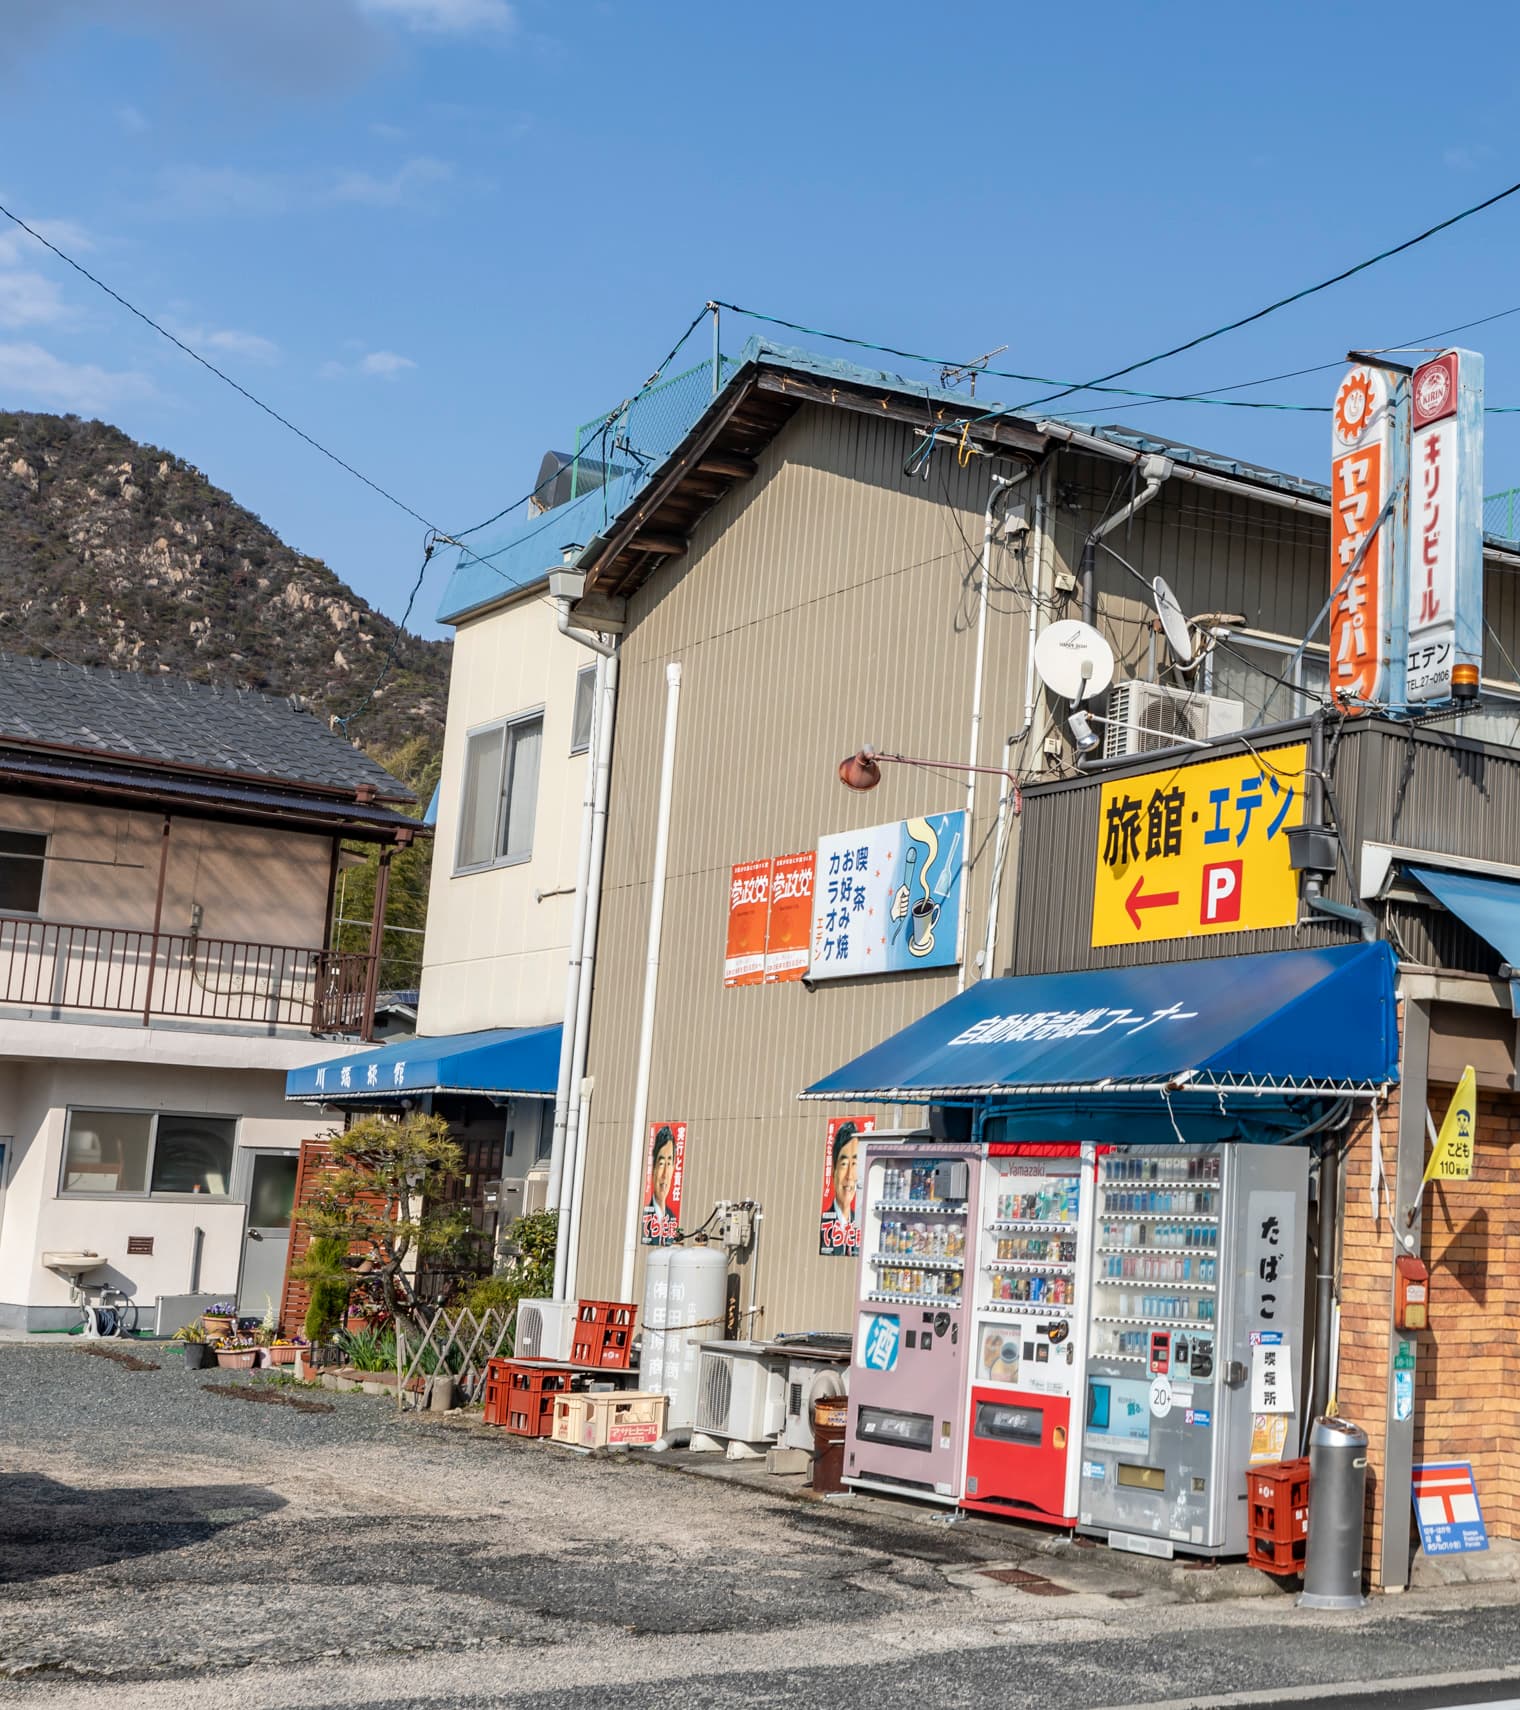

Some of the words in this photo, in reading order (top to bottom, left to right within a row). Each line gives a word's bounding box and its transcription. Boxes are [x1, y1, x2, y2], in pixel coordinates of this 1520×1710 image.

[1423, 388, 1444, 404] KIRIN
[1419, 432, 1442, 624] キリンビール
[1407, 643, 1450, 672] エデン
[731, 874, 768, 911] 参政党
[773, 867, 812, 905] 参政党
[852, 846, 869, 912] 喫茶
[1206, 867, 1236, 920] P
[823, 851, 841, 961] カラオケ
[836, 850, 855, 960] お好み焼
[814, 918, 823, 961] エデン
[947, 1001, 1198, 1046] 自動販売機コーナー
[315, 1061, 407, 1090] 川端旅館
[672, 1126, 686, 1201] 実行と責任
[1008, 1161, 1046, 1177] Yamazaki
[1447, 1141, 1470, 1158] こども
[1259, 1216, 1284, 1320] たばこ
[867, 1315, 899, 1371] 酒
